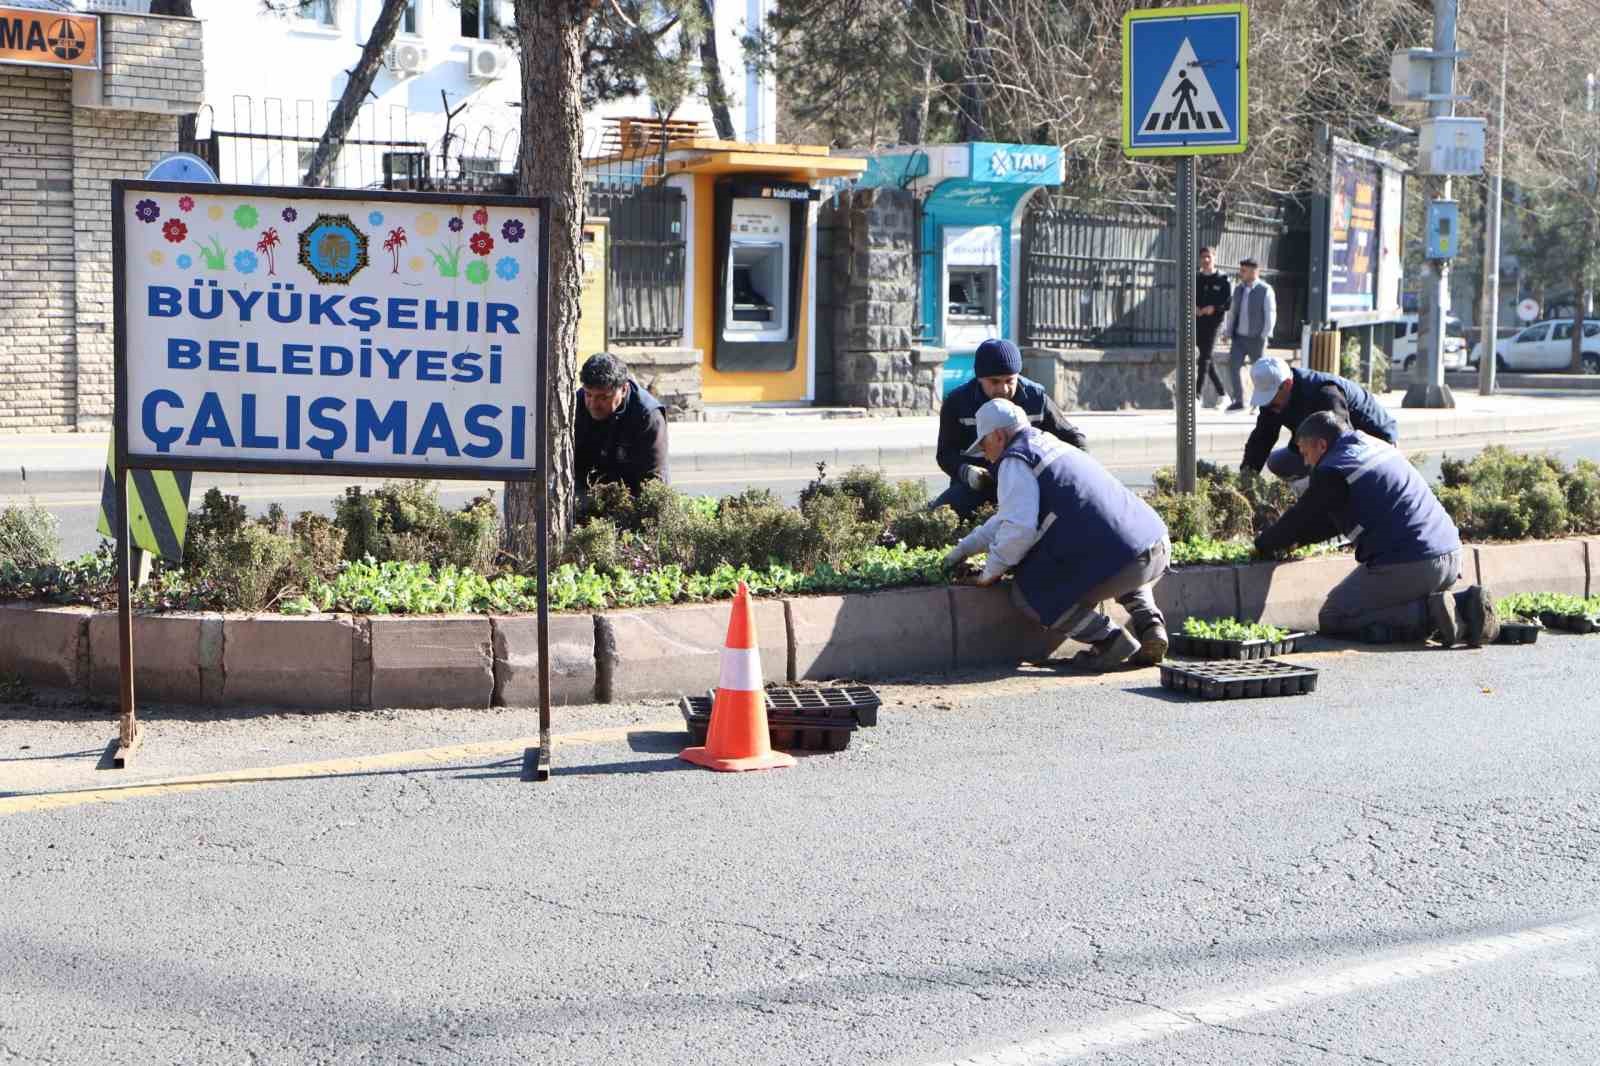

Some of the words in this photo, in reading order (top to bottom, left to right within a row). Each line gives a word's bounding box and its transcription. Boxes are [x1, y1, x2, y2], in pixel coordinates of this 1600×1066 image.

[1011, 152, 1047, 171] TAM
[148, 279, 520, 334] BÜYÜKŞEHIR
[167, 338, 502, 384] BELEDİYESİ
[141, 389, 526, 460] ÇALIŞMASI
